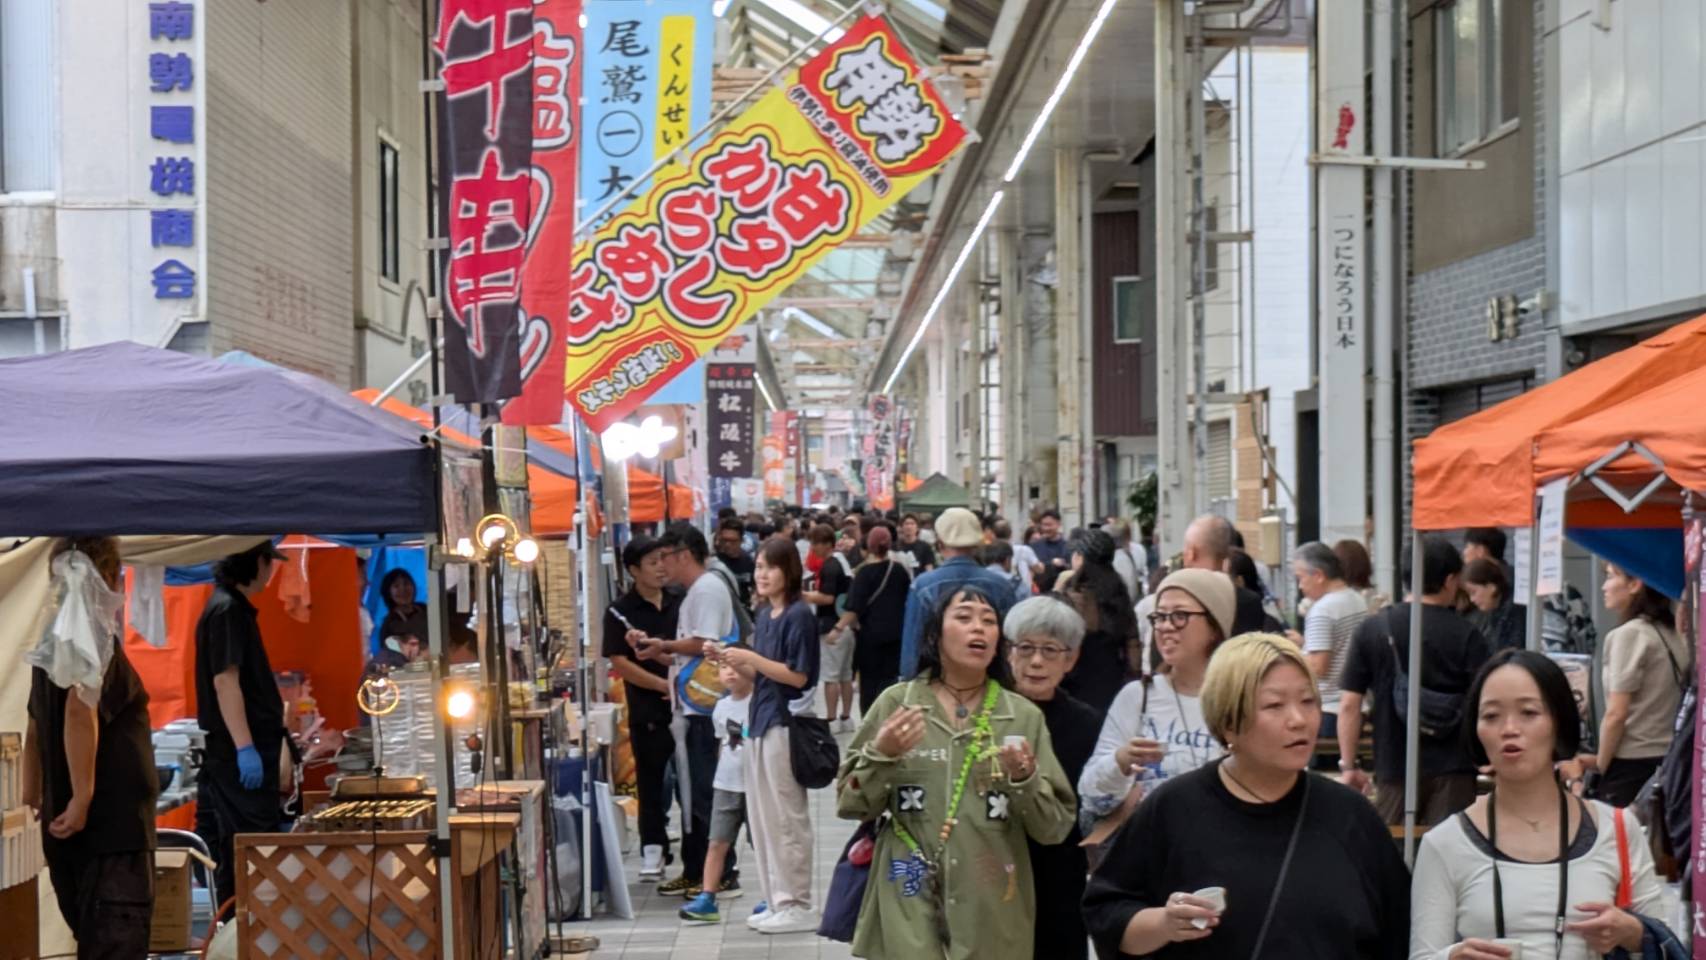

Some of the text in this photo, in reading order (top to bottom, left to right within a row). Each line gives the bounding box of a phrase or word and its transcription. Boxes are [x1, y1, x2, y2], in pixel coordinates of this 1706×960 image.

[662, 43, 688, 165] くんせい
[789, 85, 892, 197] 伊勢たまり醤油使用
[823, 36, 941, 163] 伊勢
[570, 138, 777, 344] からあげ
[1333, 213, 1356, 350] 一つになろう日本
[579, 340, 682, 413] ご当地グルメ
[717, 393, 742, 472] 松阪牛
